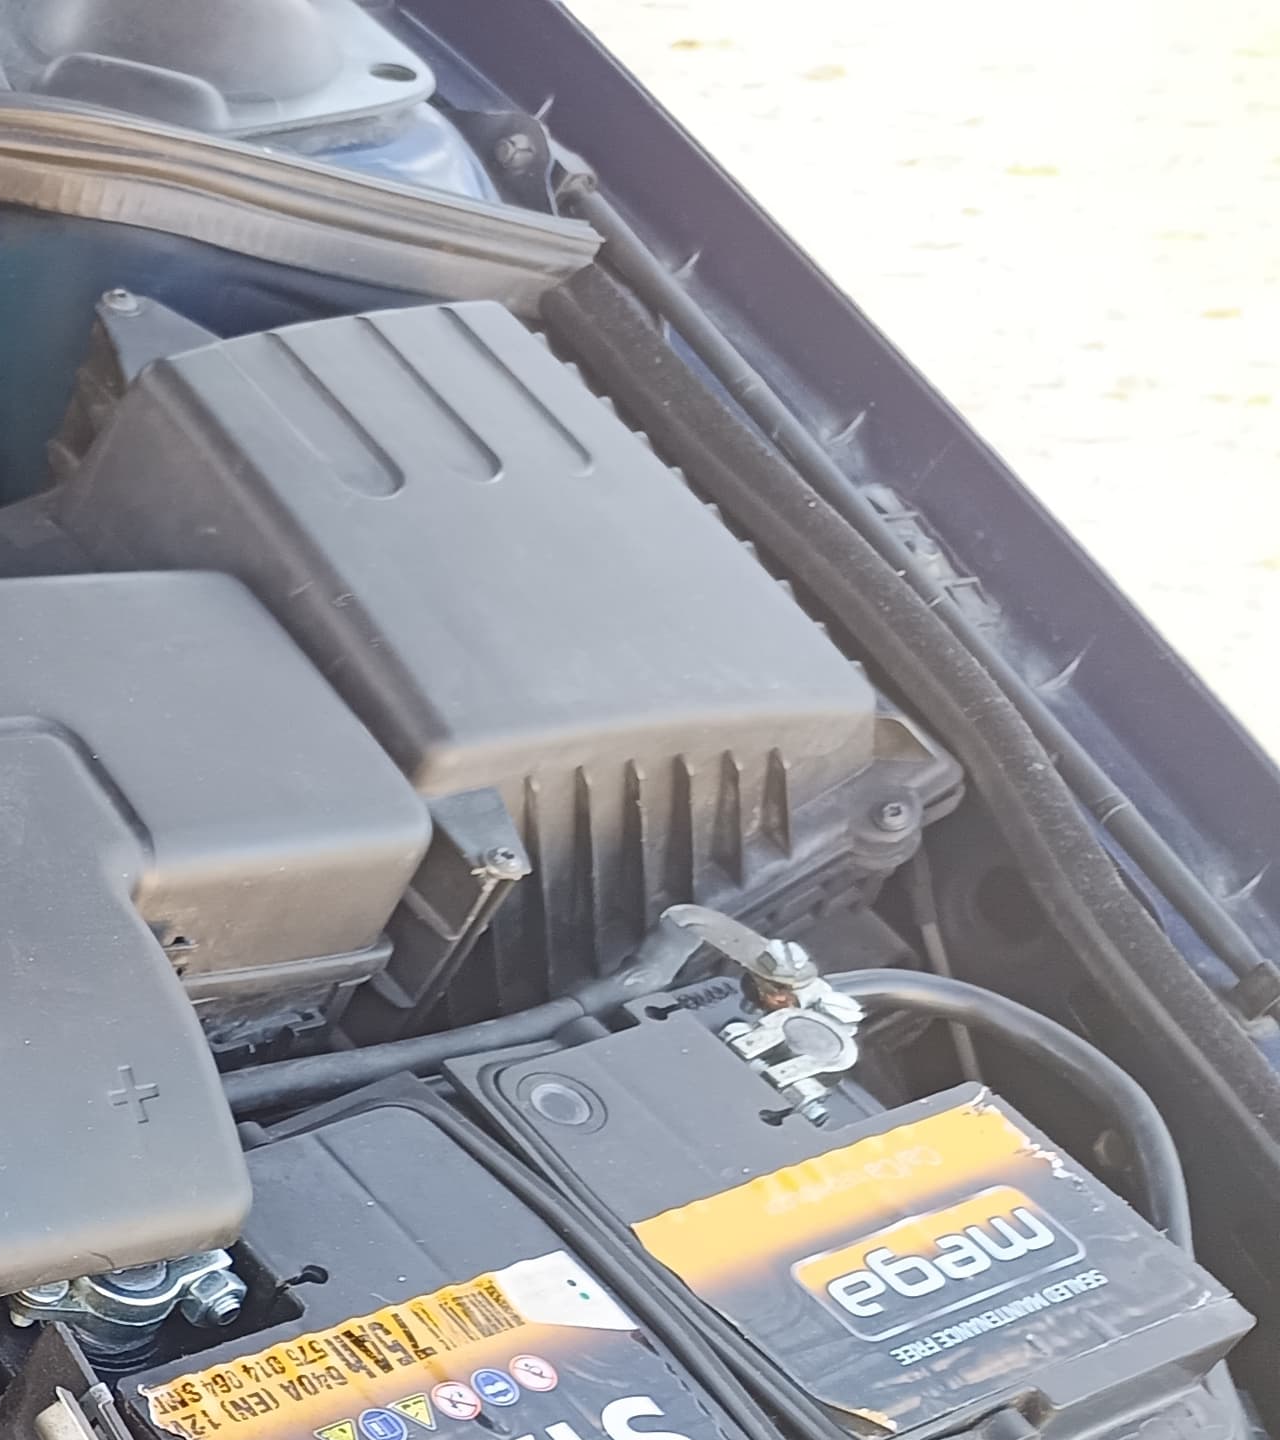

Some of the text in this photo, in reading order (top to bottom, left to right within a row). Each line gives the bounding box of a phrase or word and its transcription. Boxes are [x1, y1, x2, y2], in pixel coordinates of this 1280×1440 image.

[825, 1207, 1056, 1317] mega
[324, 1313, 438, 1379] 75Ah
[889, 1269, 1108, 1367] SEALED MAINTENANCE FREE
[221, 1387, 281, 1422] (EN)
